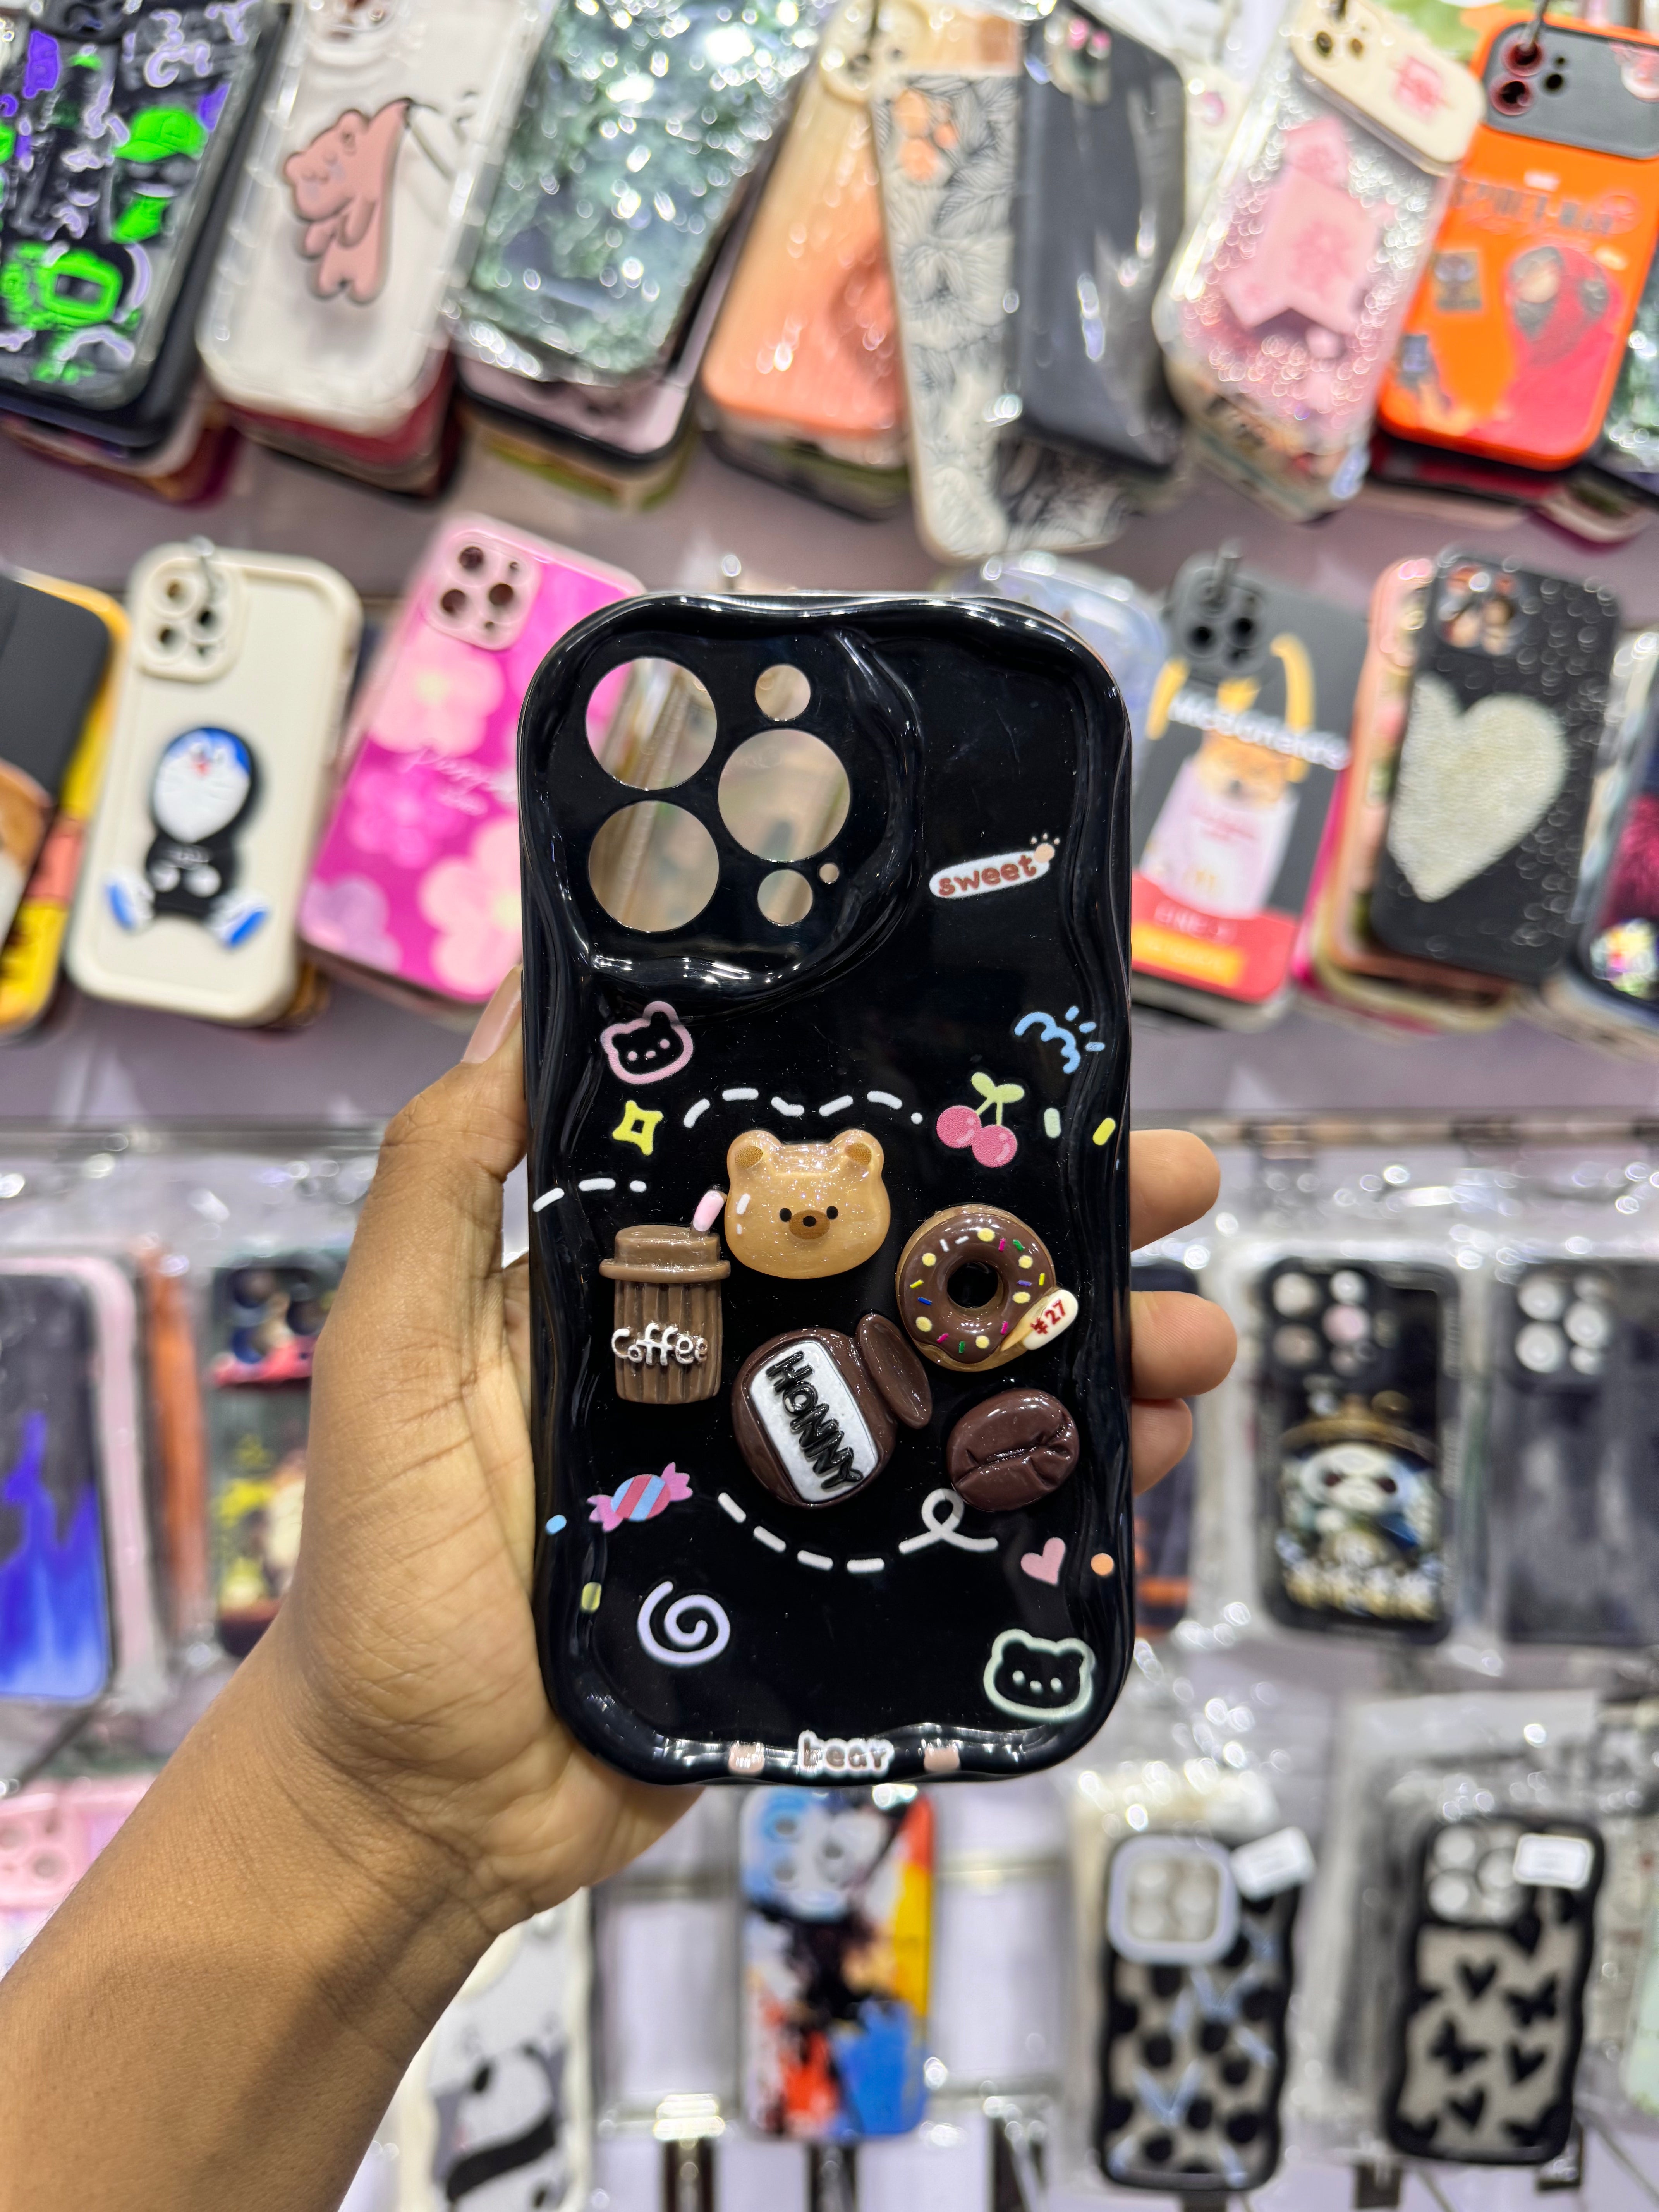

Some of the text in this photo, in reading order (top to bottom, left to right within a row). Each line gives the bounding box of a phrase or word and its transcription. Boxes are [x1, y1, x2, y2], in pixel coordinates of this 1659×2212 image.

[938, 855, 1037, 896] sweet
[611, 1322, 708, 1366] Coffee
[765, 1350, 864, 1490] HONNY
[799, 1733, 891, 1772] bear
